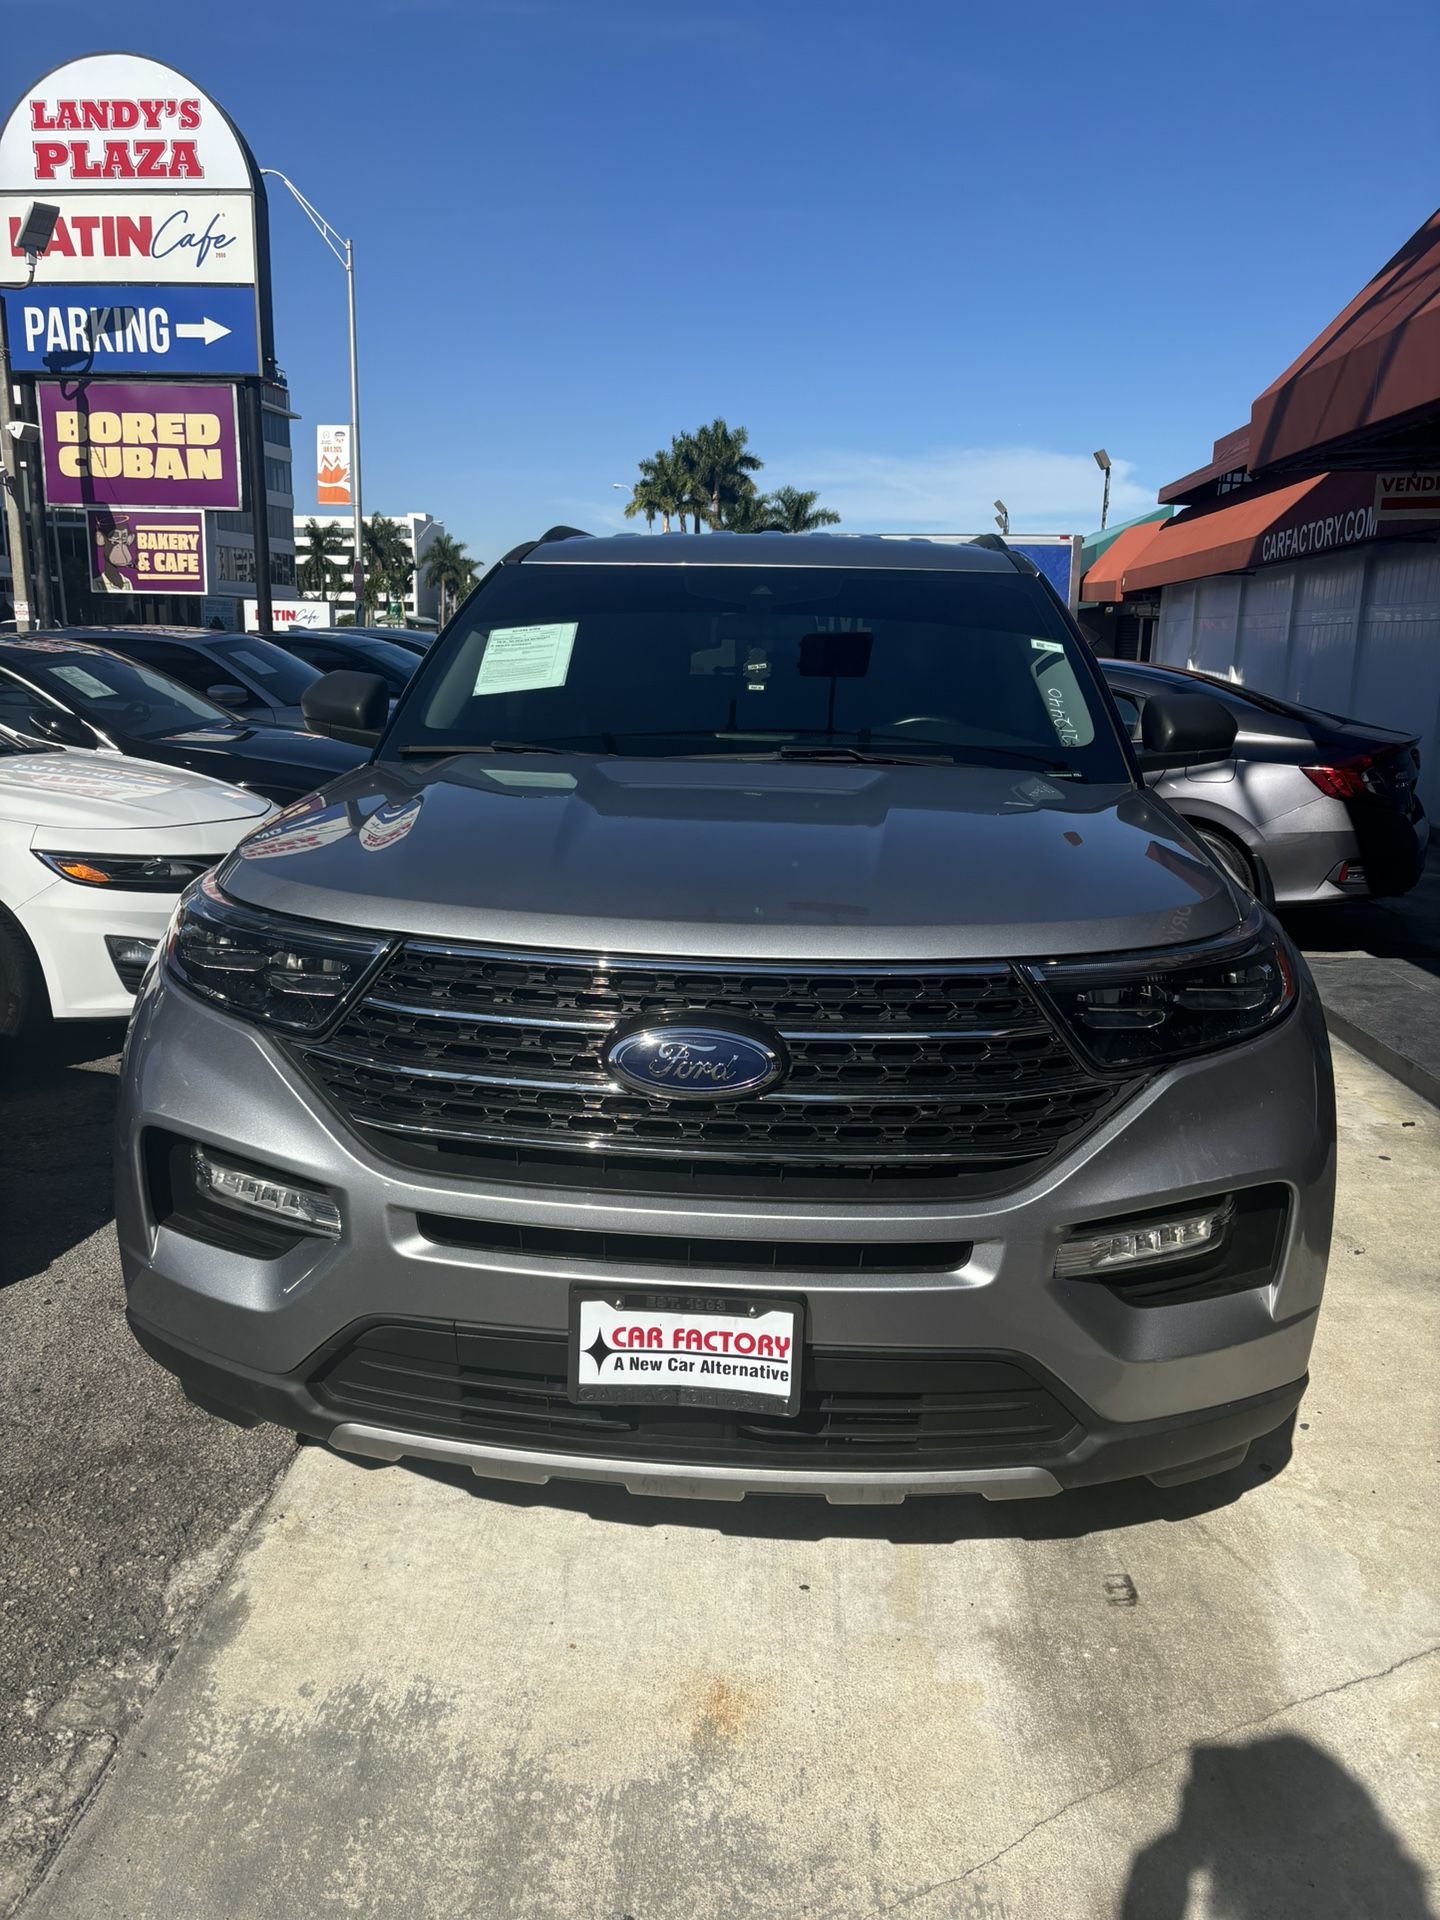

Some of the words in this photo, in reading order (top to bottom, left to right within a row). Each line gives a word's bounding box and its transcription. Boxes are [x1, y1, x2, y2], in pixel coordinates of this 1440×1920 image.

[30, 99, 202, 131] LANDY'S
[32, 139, 205, 179] PLAZA
[8, 215, 153, 257] LATIN
[151, 209, 236, 267] Cafe
[23, 306, 170, 353] PARKING
[56, 411, 220, 445] BORED
[58, 446, 223, 480] CUBAN
[137, 532, 200, 551] BAKERY
[1262, 506, 1378, 561] CARFACTORY.COM
[138, 554, 151, 572] &
[154, 553, 199, 572] CAFE
[648, 1041, 739, 1081] Ford
[612, 1326, 663, 1348] CAR
[672, 1328, 790, 1358] FACTORY
[613, 1357, 624, 1371] A
[629, 1357, 663, 1372] New
[667, 1358, 695, 1373] Car
[700, 1360, 789, 1382] Alternative
